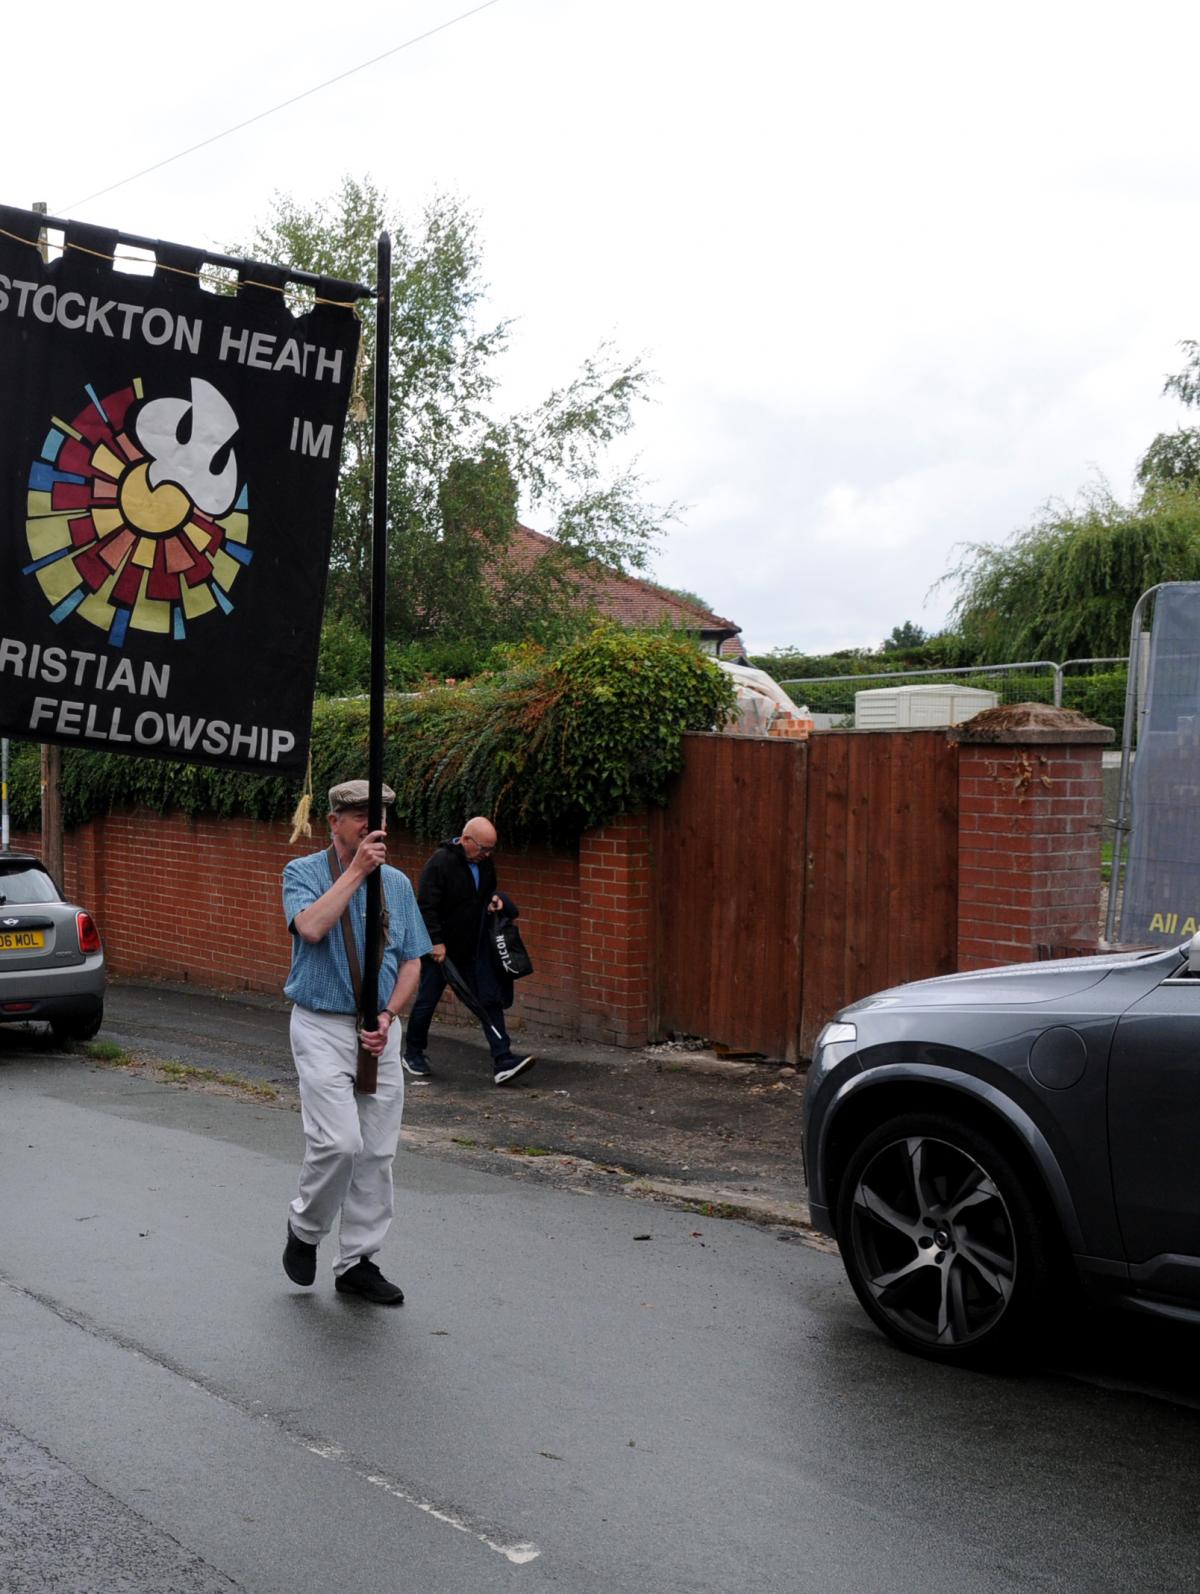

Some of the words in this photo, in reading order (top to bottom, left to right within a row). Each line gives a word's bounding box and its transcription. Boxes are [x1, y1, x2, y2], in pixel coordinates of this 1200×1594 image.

[290, 416, 334, 459] IM
[28, 696, 295, 763] FELLOWSHIP
[1149, 912, 1178, 934] All
[1181, 916, 1198, 936] A
